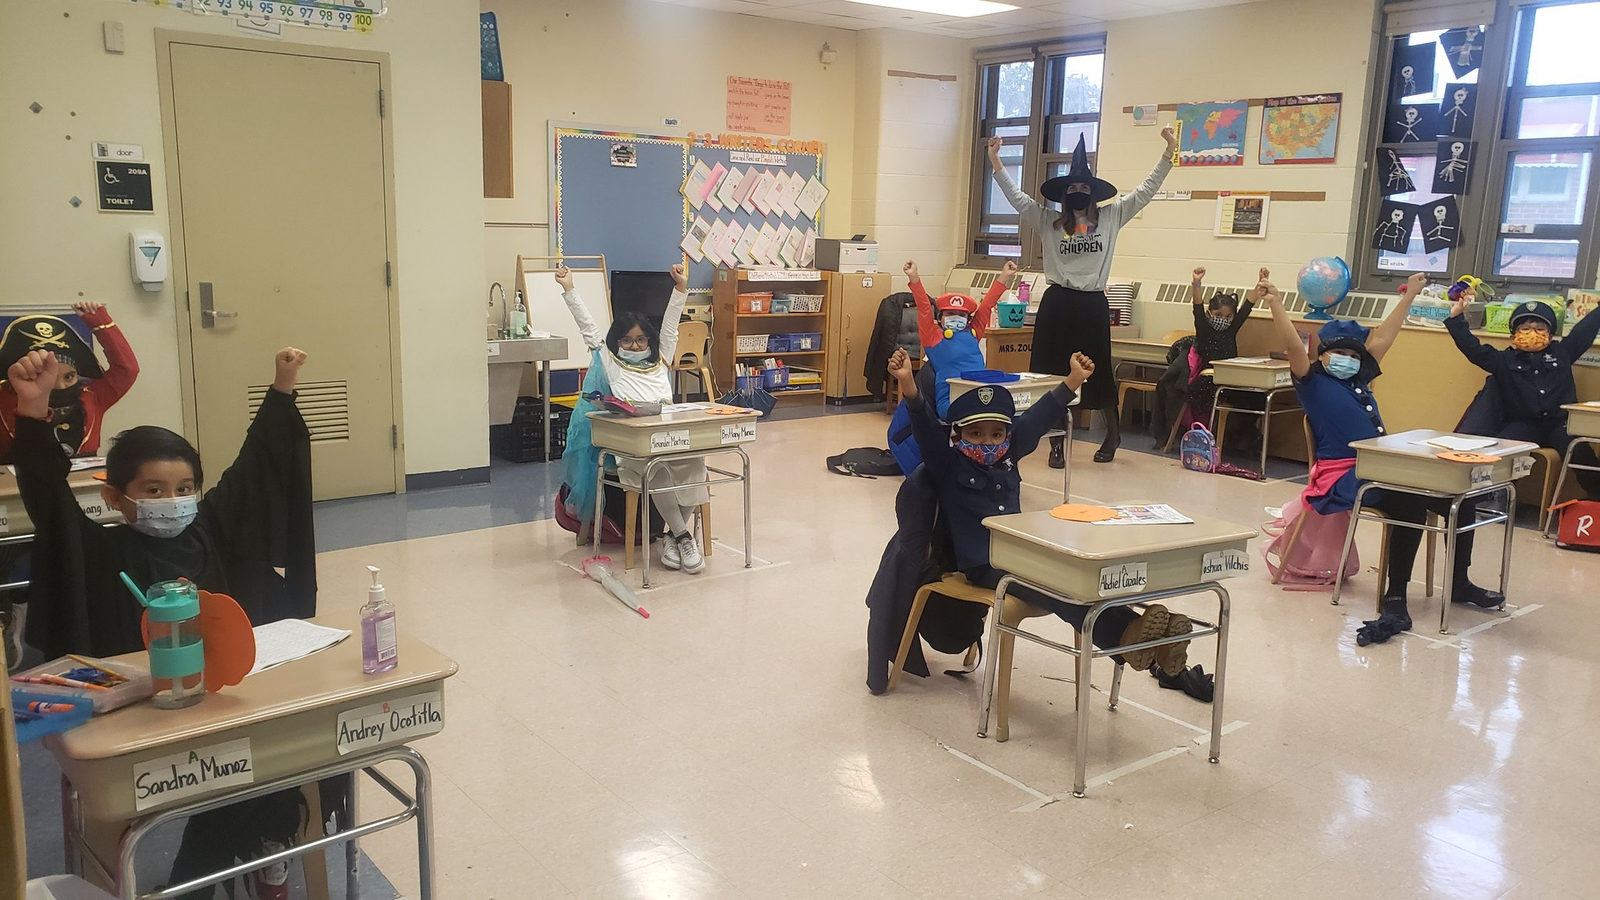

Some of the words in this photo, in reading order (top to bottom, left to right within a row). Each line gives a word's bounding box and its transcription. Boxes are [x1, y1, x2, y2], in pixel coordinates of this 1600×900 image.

[238, 0, 253, 11] 94
[259, 2, 274, 14] 95
[279, 5, 294, 17] 96
[300, 8, 314, 18] 97
[319, 10, 333, 21] 98
[338, 12, 352, 24] 99
[355, 14, 372, 26] 100
[687, 131, 712, 147] 2-3
[717, 132, 772, 150] WRITERS
[777, 138, 824, 156] CORNER
[116, 149, 134, 157] door
[1060, 240, 1103, 255] CHILDREN
[951, 297, 962, 306] M
[999, 343, 1016, 353] MRS.
[1576, 514, 1594, 537] R
[1224, 554, 1249, 571] Vilchis
[1100, 571, 1121, 591] Abdiel
[382, 702, 391, 713] B
[337, 718, 386, 746] Andrey
[389, 702, 442, 733] Ocotitla
[187, 750, 199, 765] A
[135, 764, 199, 800] Sandra
[200, 757, 252, 783] Munoz
